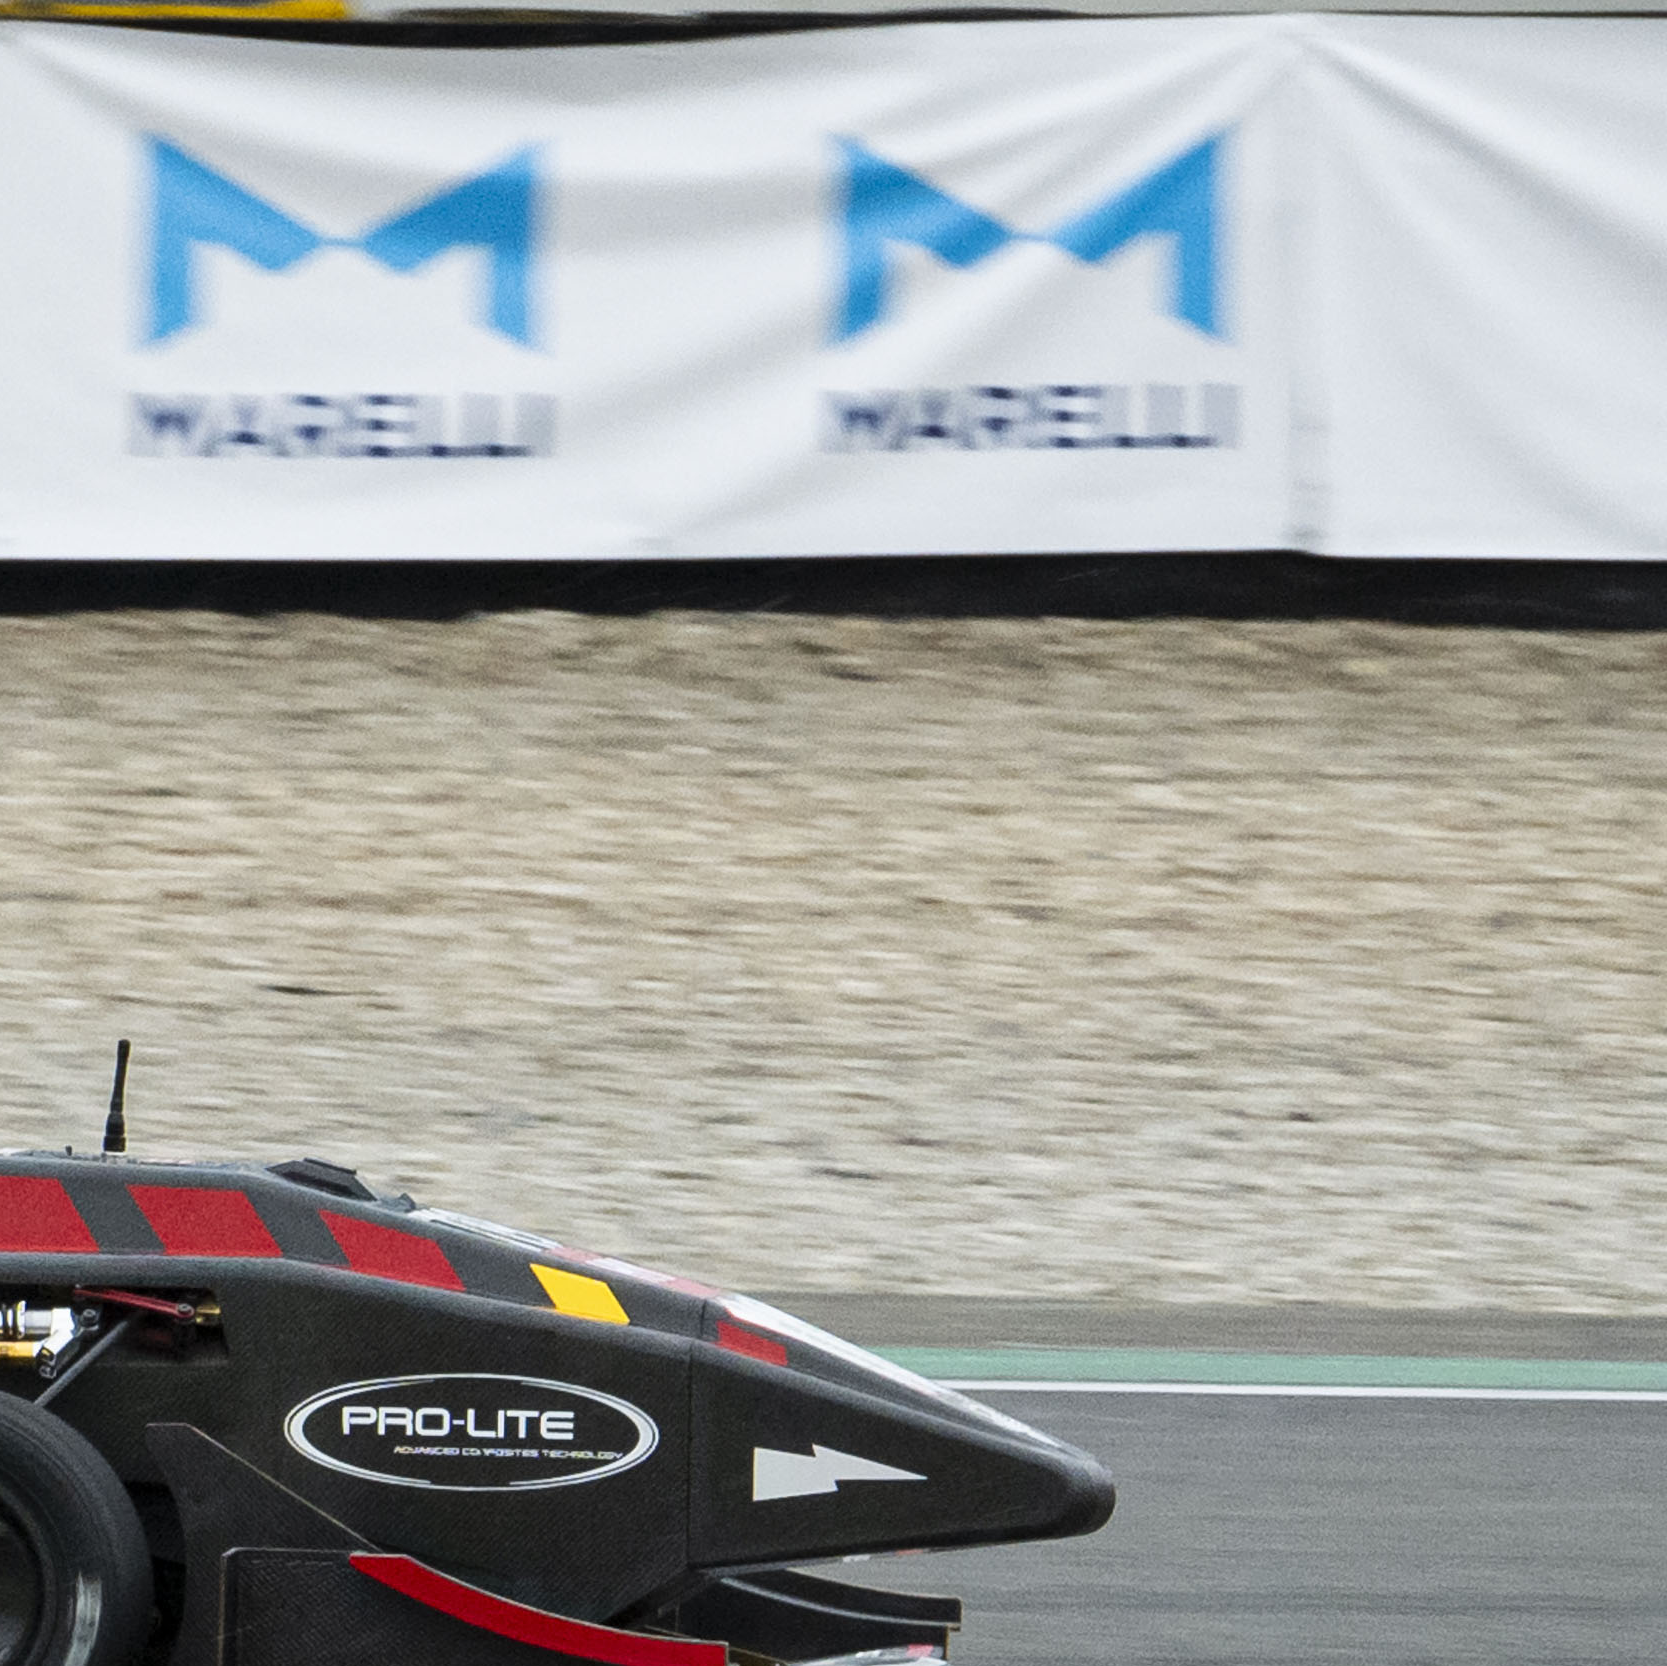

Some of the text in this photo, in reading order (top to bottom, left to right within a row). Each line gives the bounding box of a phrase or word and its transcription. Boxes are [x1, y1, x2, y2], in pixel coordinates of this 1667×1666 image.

[126, 393, 556, 457] MARELLI
[819, 384, 1239, 451] MARELLI
[341, 1405, 575, 1441] PRO-LITE
